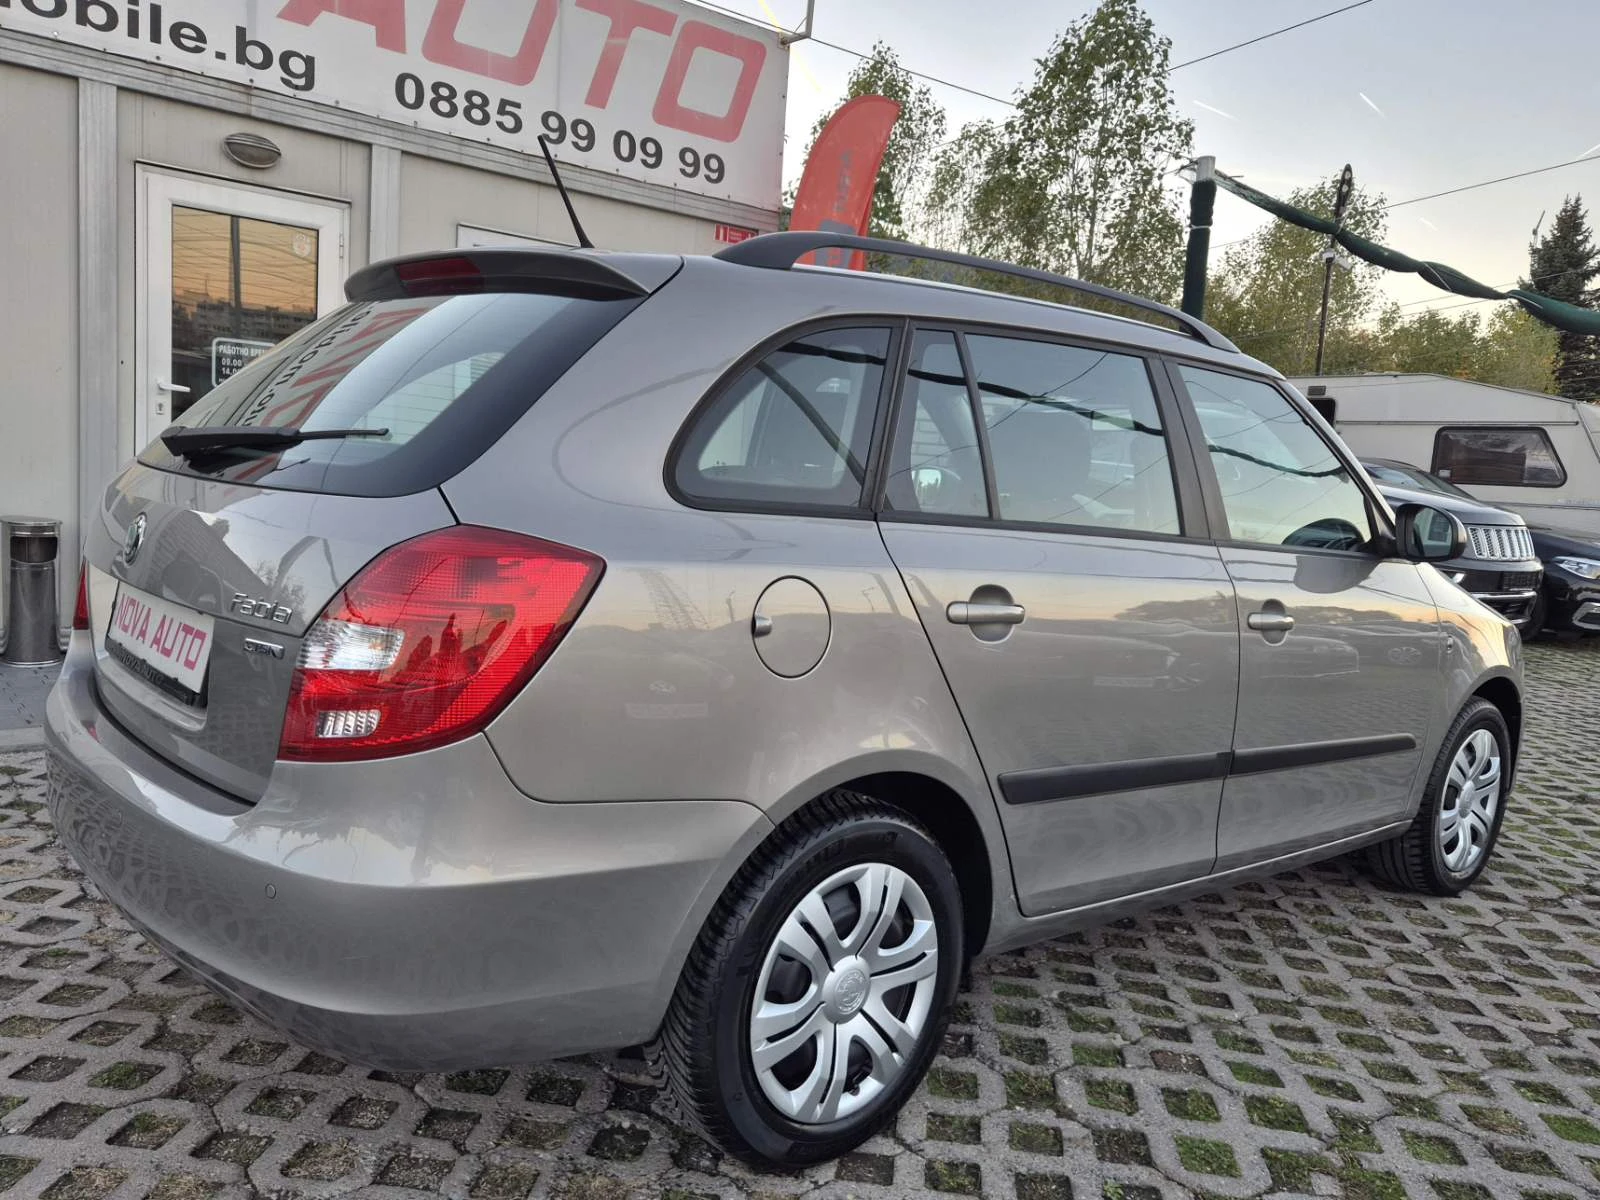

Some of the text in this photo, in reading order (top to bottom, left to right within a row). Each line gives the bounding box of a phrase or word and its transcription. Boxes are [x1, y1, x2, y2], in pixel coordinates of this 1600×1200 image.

[0, 0, 316, 91] obile.bg
[394, 71, 726, 184] 0885 99 09 99
[221, 358, 243, 367] 09.00
[221, 367, 240, 375] 14.0
[114, 592, 152, 644] NOVA
[150, 614, 209, 671] AUTO
[230, 592, 293, 625] Fabia
